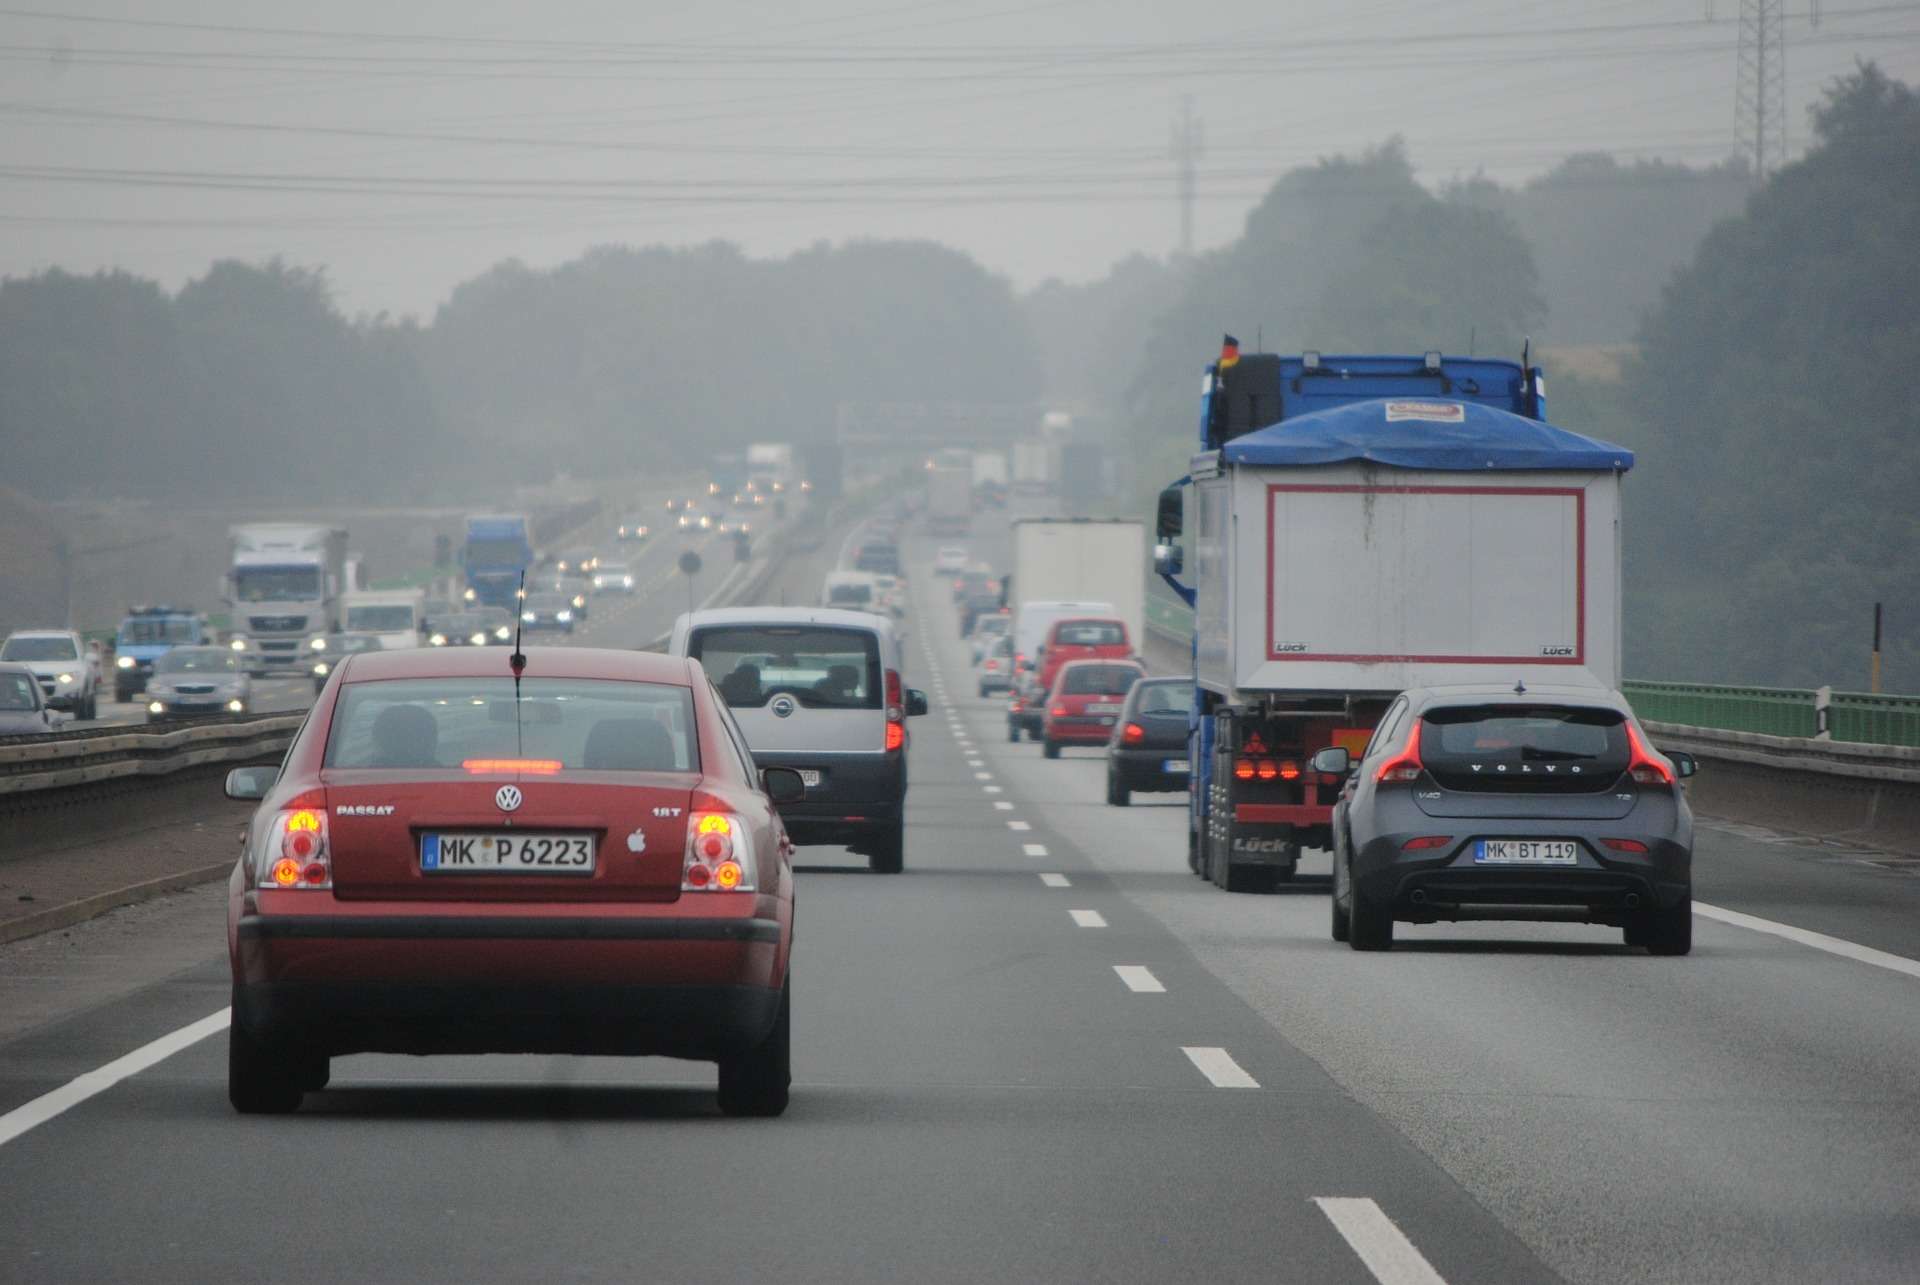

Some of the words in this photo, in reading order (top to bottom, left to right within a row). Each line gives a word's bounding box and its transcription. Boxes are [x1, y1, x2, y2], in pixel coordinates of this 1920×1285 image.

[1471, 764, 1581, 774] VOLVO
[336, 804, 395, 817] PASSAT
[440, 839, 475, 865] MK
[497, 839, 513, 865] P
[520, 839, 588, 866] 6223
[1487, 842, 1507, 858] MK
[1519, 842, 1540, 859] BT
[1543, 843, 1575, 859] 119
